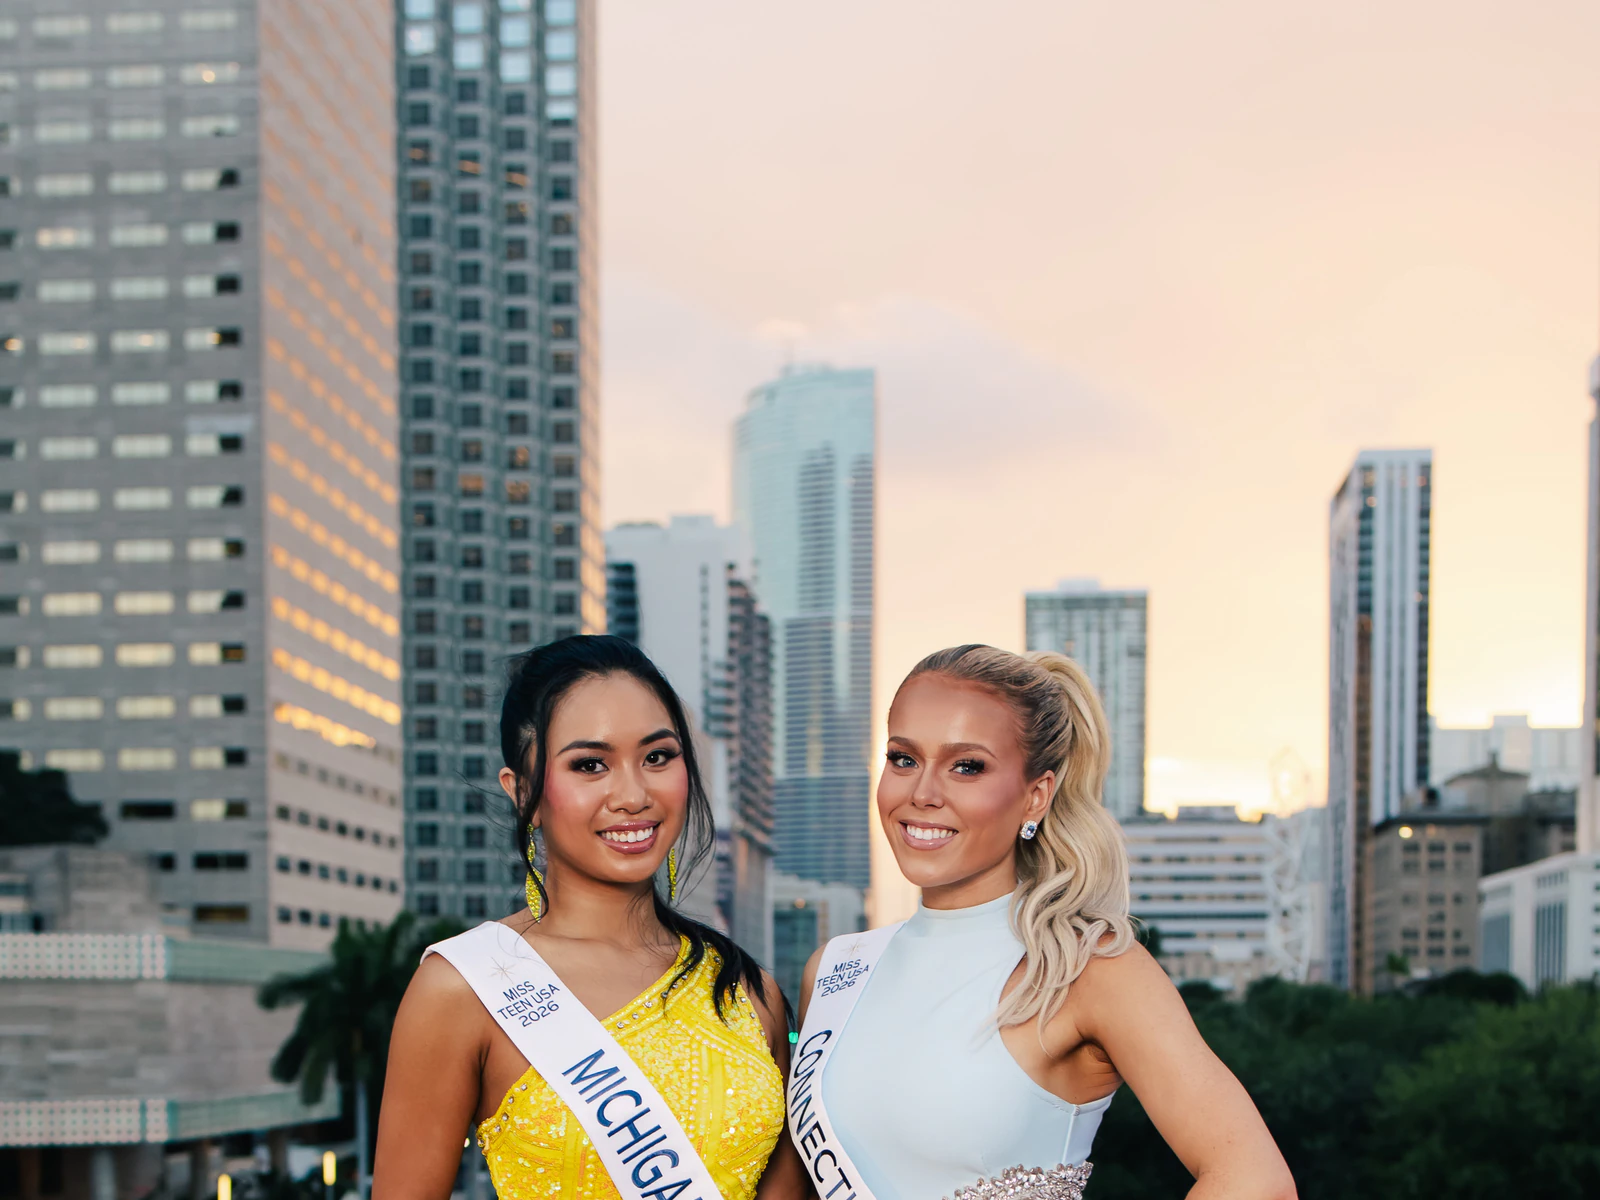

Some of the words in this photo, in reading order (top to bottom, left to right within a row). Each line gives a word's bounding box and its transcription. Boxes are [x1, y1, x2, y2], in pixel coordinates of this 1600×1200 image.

[817, 972, 846, 989] TEEN
[847, 964, 869, 979] USA
[833, 959, 861, 974] MISS
[503, 981, 535, 1002] MISS
[821, 978, 857, 997] 2026
[497, 998, 533, 1019] TEEN
[530, 984, 560, 1003] USA
[519, 1000, 559, 1027] 2026
